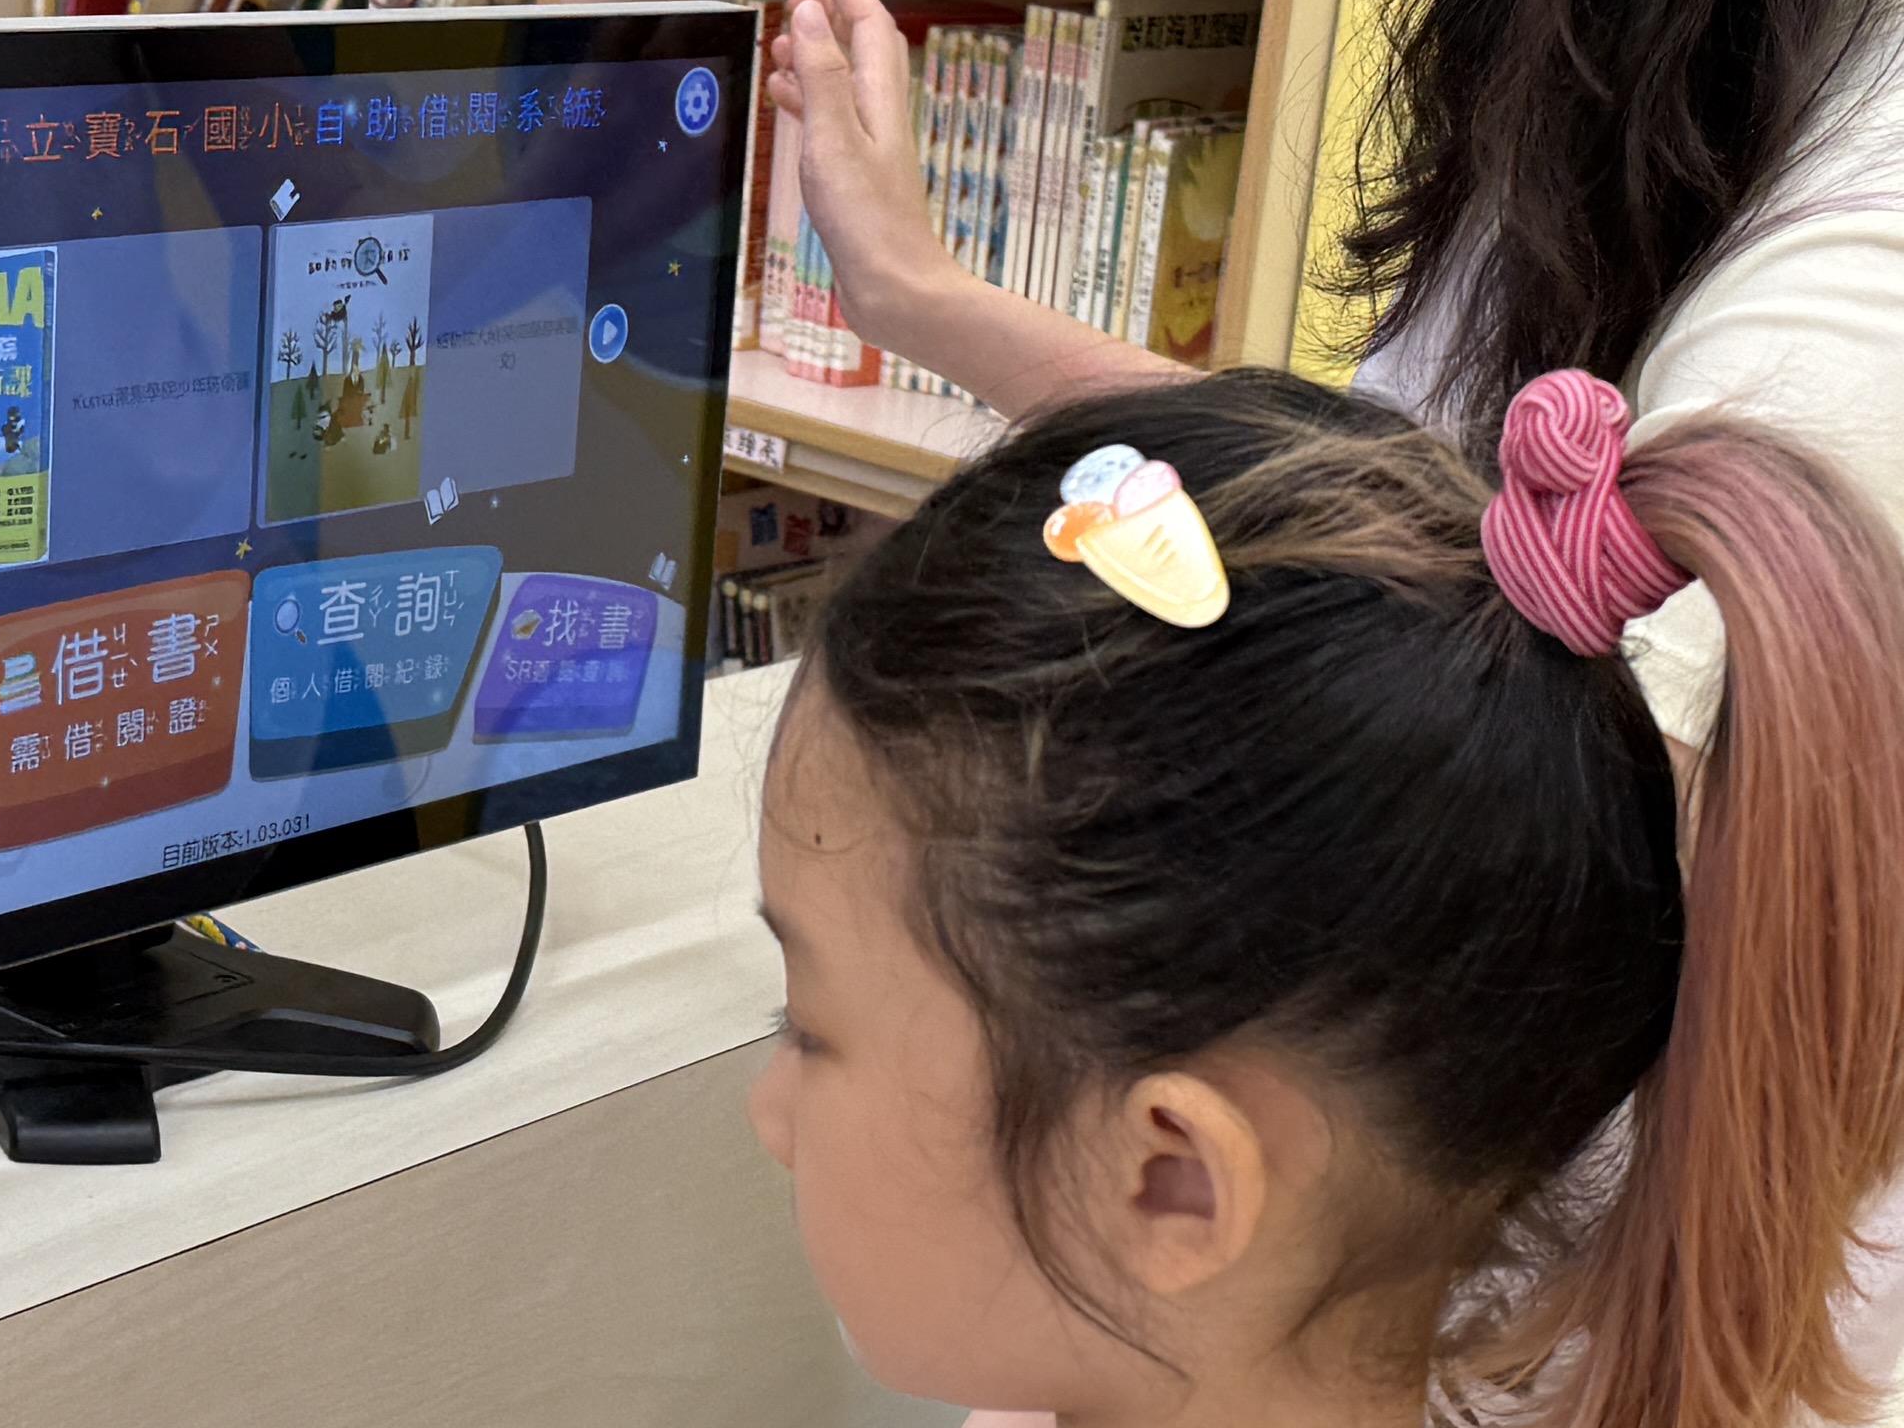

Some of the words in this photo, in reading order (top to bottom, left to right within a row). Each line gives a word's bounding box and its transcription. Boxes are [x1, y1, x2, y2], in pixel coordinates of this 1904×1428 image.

[317, 570, 462, 646] 查詢
[543, 599, 646, 650] 找書
[51, 612, 219, 706] 借書
[269, 652, 450, 705] 個人借閱紀錄
[10, 696, 208, 774] 需借閱證
